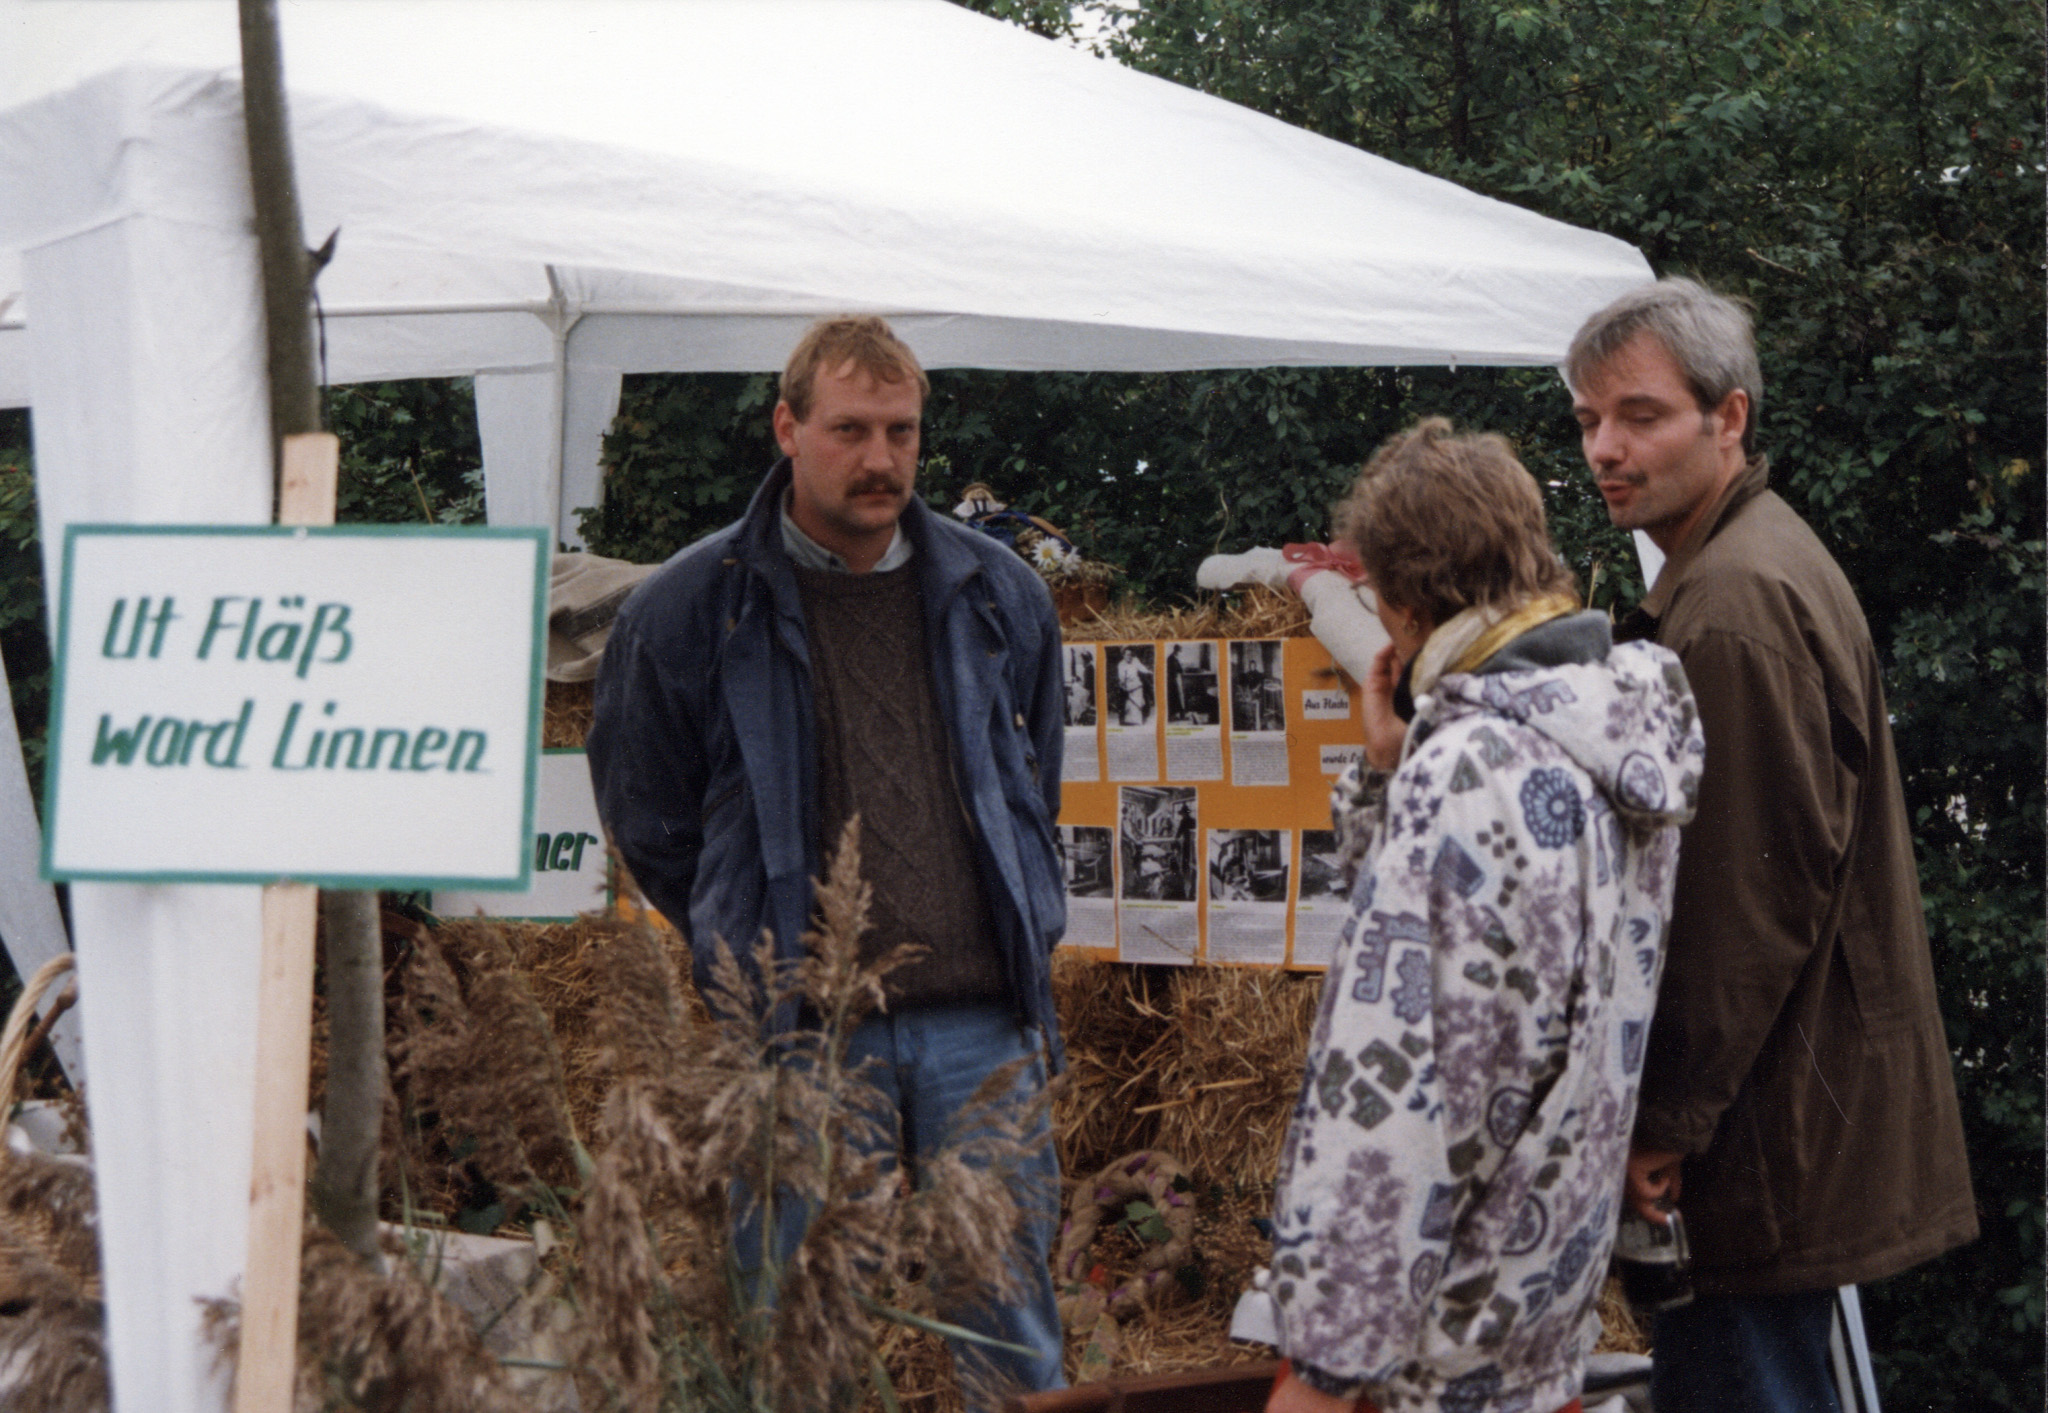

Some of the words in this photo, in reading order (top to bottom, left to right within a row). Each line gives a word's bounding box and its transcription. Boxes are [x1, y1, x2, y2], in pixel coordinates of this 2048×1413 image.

[100, 596, 182, 660] Ut
[196, 595, 354, 680] Fläß
[270, 701, 494, 774] Linnen
[1304, 698, 1320, 711] Aus
